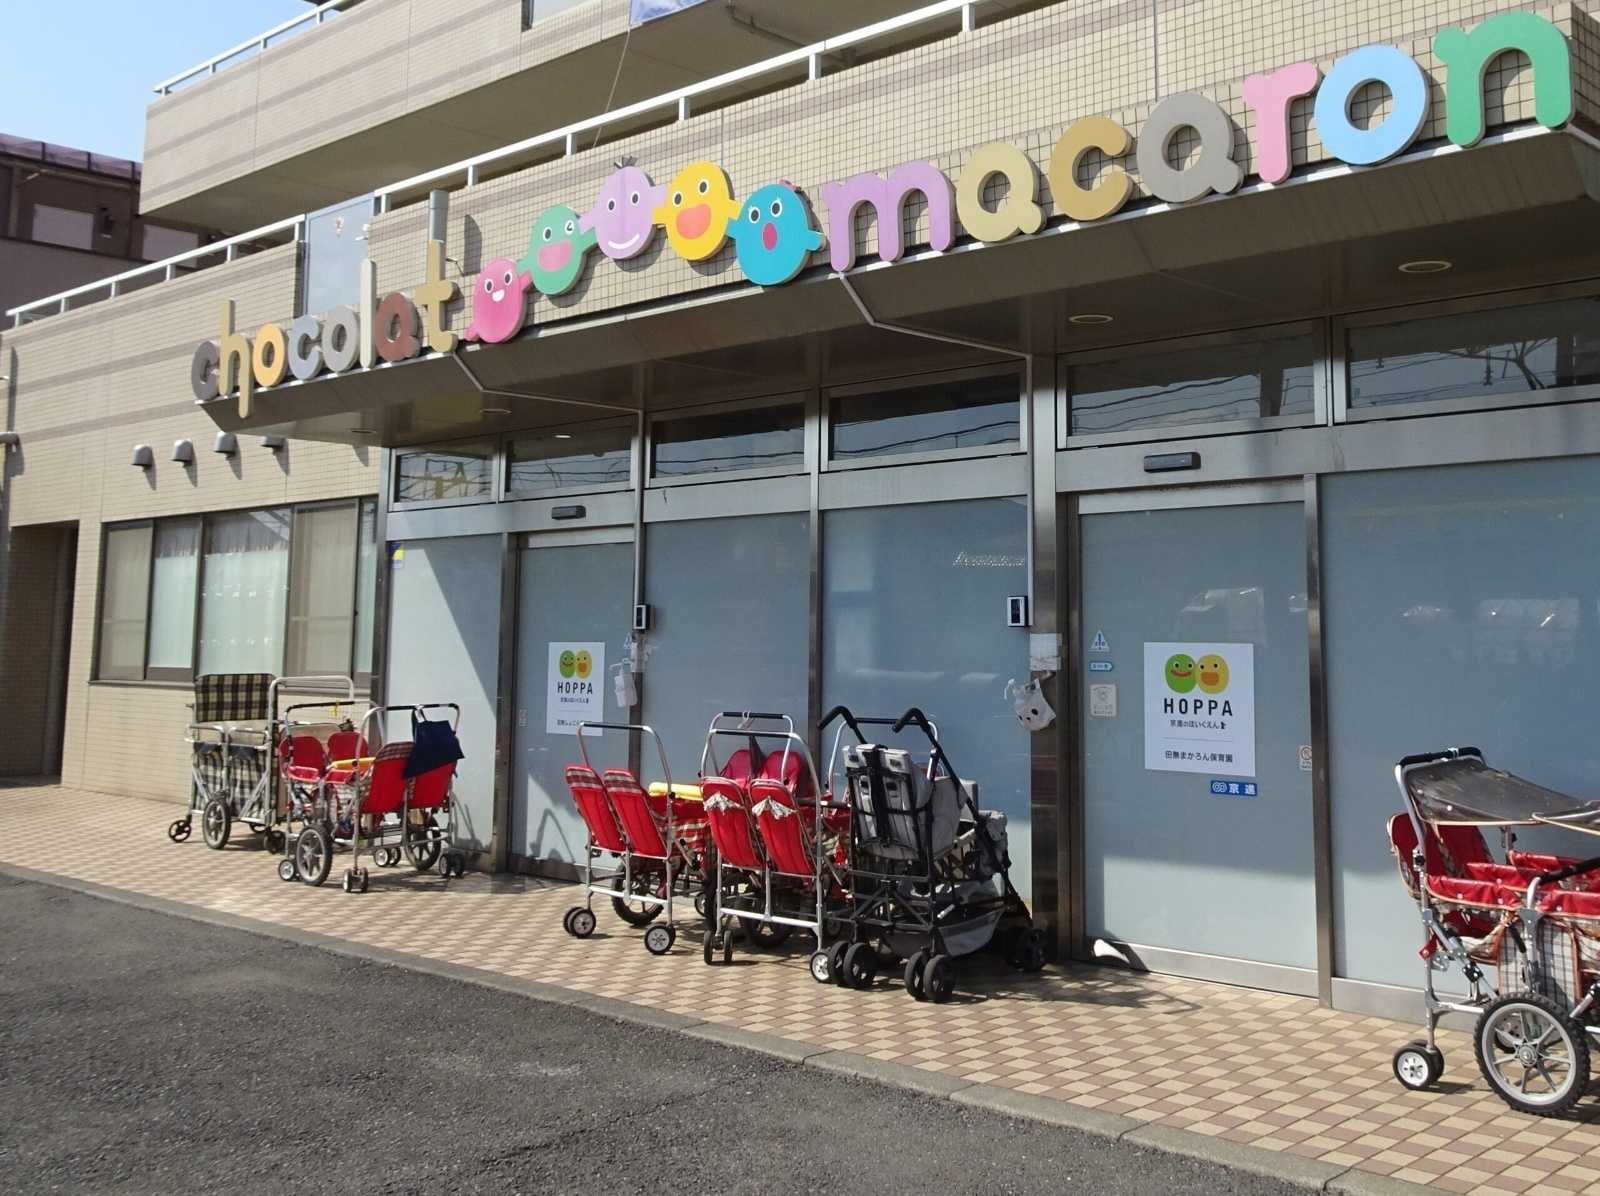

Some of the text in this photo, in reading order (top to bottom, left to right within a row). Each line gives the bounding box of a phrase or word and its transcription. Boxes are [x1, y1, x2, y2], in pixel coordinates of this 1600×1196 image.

[822, 11, 1575, 273] macaron
[190, 240, 459, 419] chocolat
[557, 681, 593, 695] HOPPA
[1163, 697, 1233, 717] HOPPA
